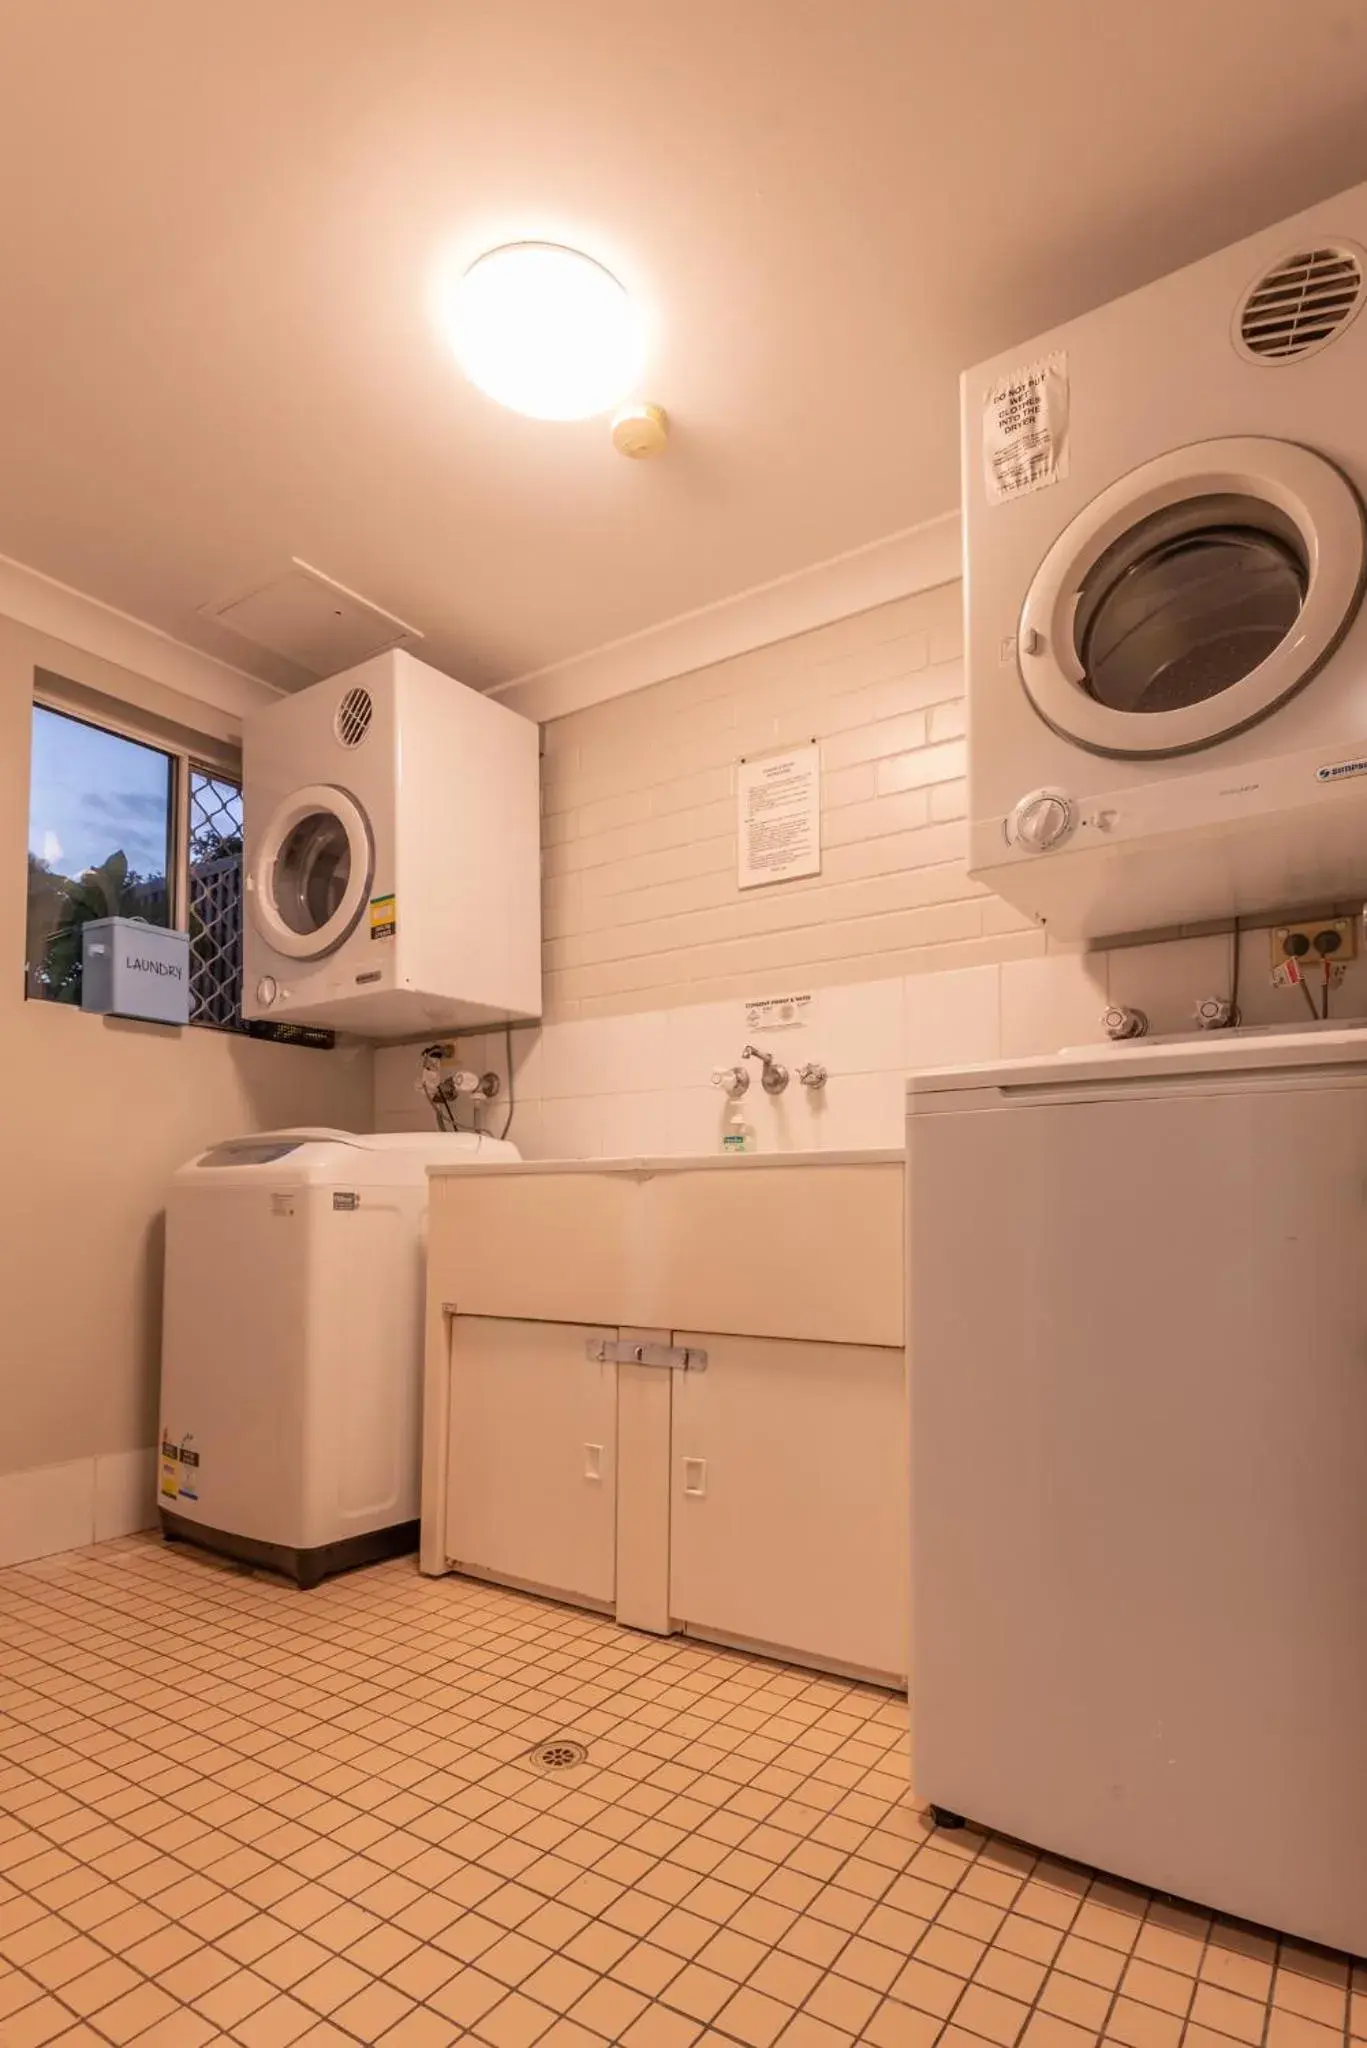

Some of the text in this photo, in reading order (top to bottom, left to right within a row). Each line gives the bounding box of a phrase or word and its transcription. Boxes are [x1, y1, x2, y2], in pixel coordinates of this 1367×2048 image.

[993, 374, 1045, 404] DO NOT PUT
[1010, 391, 1030, 405] WET
[999, 397, 1041, 418] CLOTHES
[999, 406, 1041, 429] INTO THE
[1004, 416, 1036, 434] DRYER
[126, 956, 183, 981] LAUNDRY
